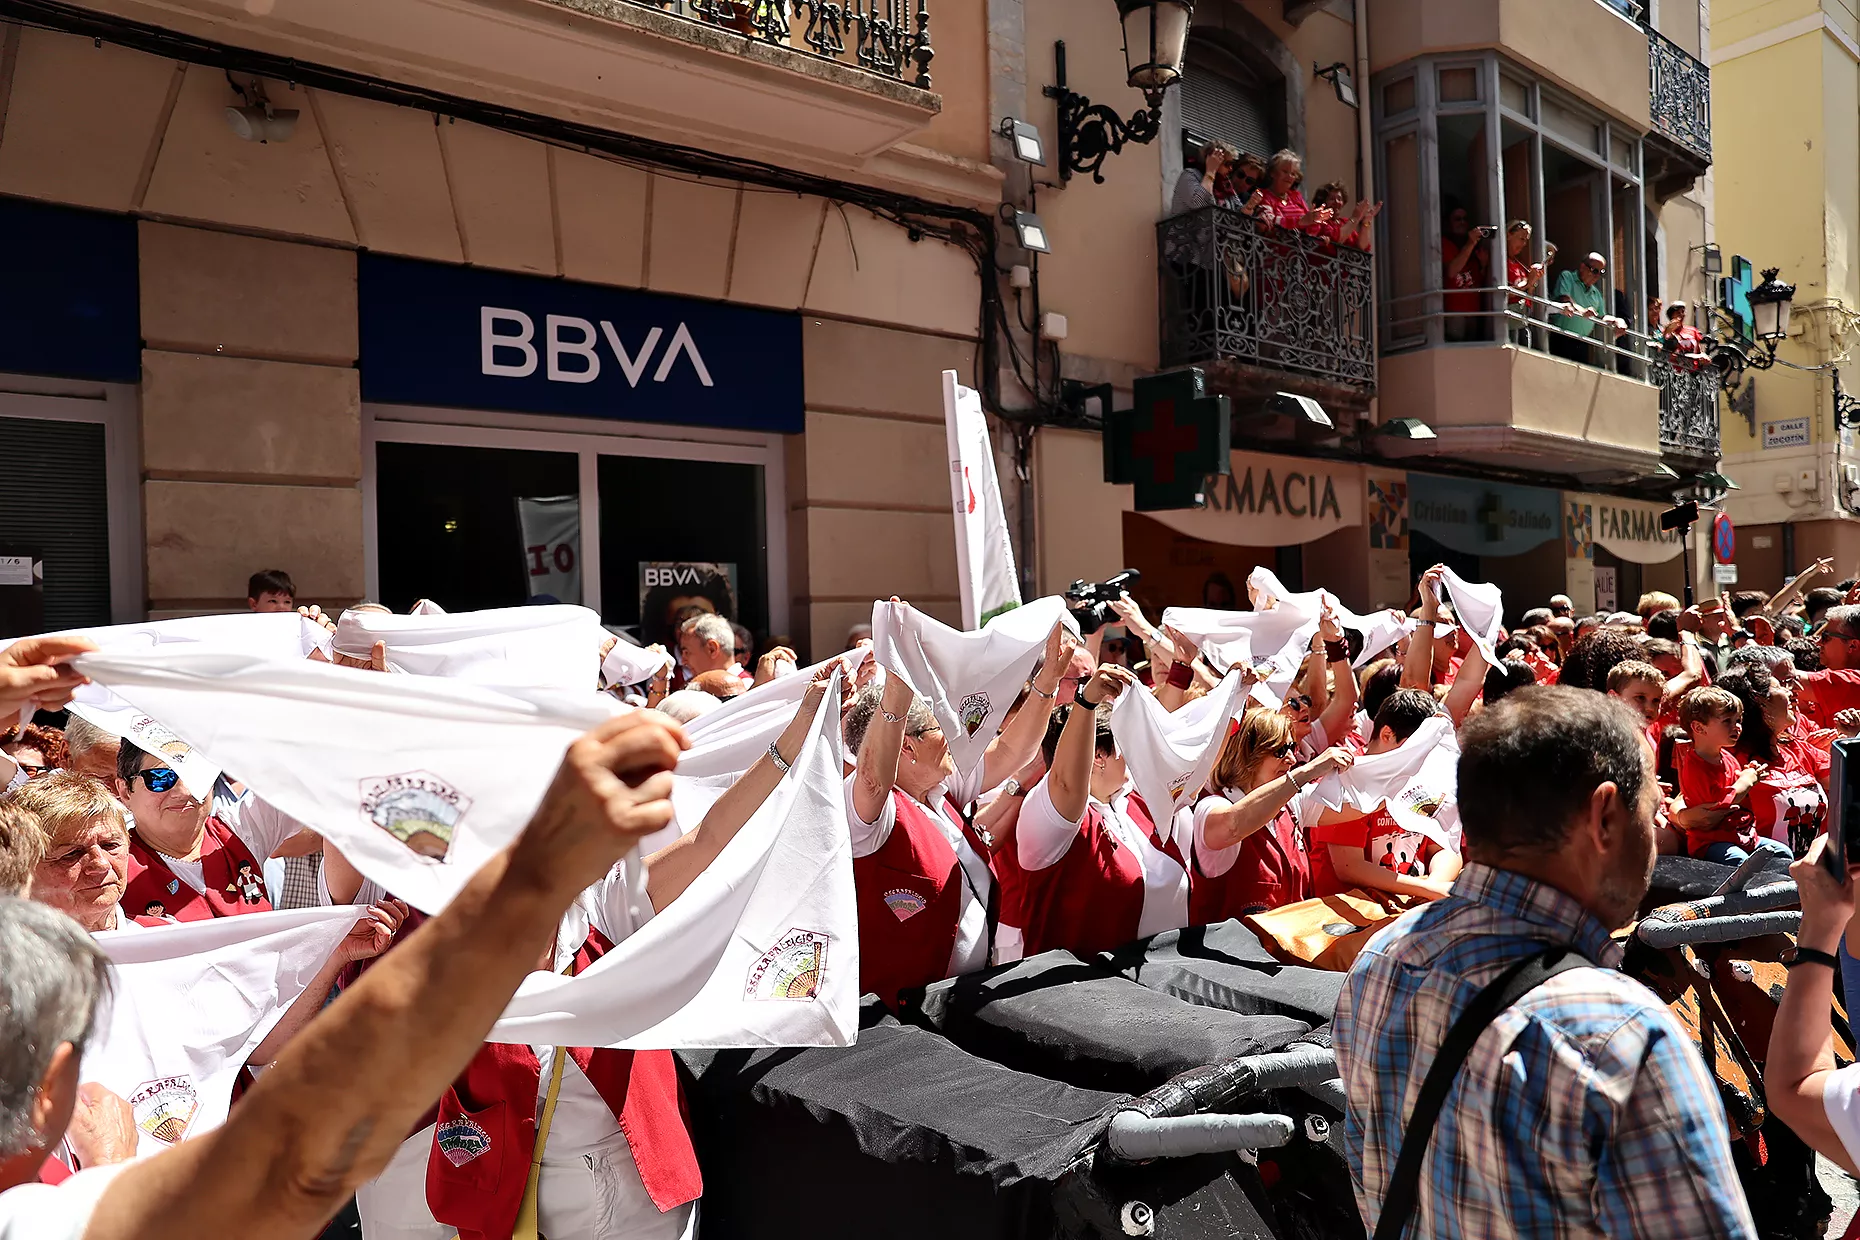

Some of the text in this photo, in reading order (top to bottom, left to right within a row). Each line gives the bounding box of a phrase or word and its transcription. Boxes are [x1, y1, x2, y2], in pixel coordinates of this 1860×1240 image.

[480, 305, 714, 388] BBVA
[1780, 422, 1805, 431] CALLE
[1203, 466, 1342, 519] RMACIA
[1414, 500, 1468, 525] Cristina
[644, 568, 701, 587] BBVA
